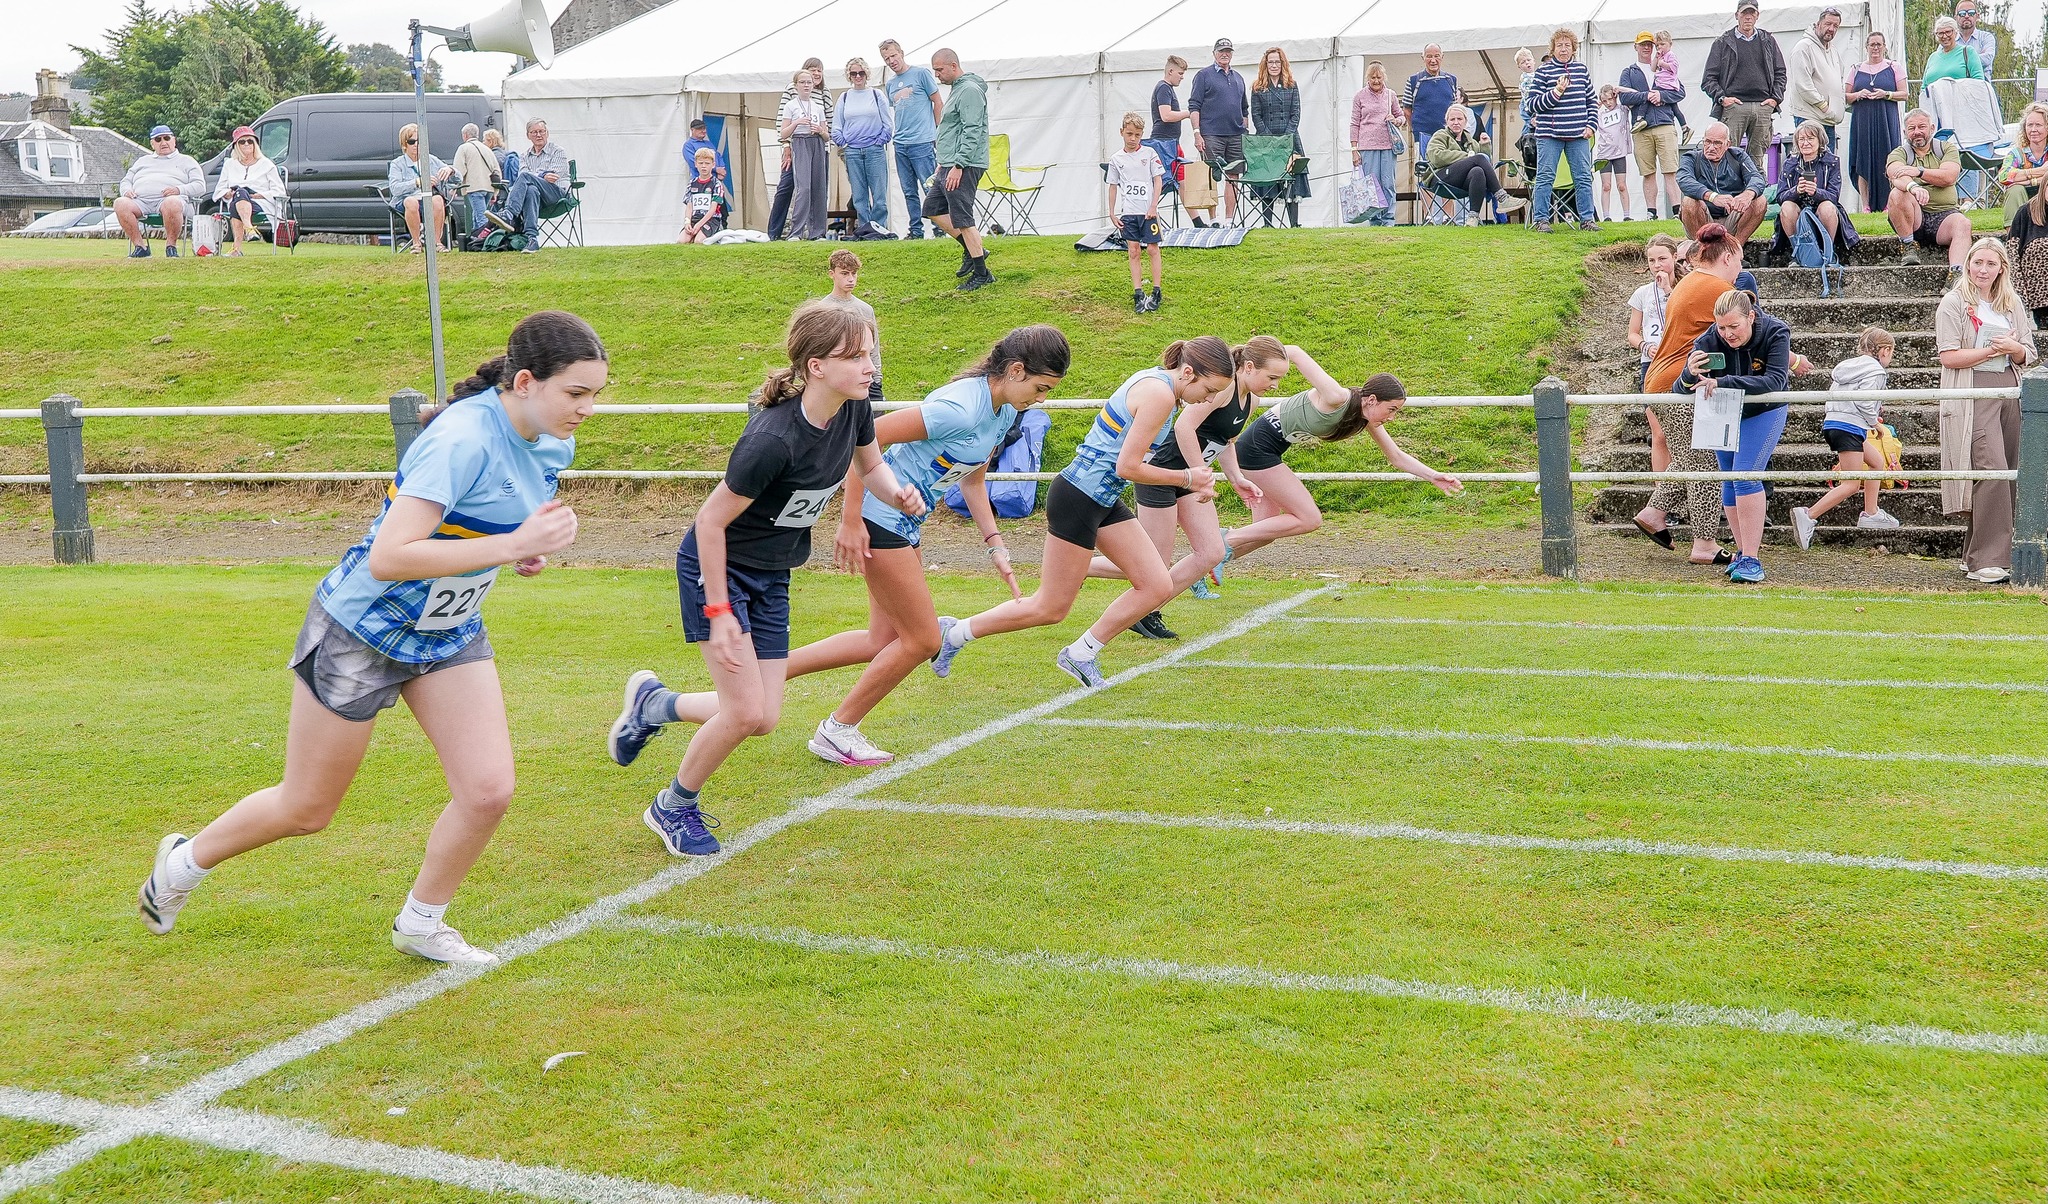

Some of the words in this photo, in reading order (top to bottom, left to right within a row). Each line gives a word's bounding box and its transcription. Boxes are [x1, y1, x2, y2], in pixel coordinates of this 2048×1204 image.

[1604, 113, 1618, 124] 211
[1126, 185, 1146, 196] 256
[693, 197, 709, 206] 252
[1151, 223, 1159, 235] 9
[785, 492, 834, 518] 24
[428, 579, 493, 618] 227
